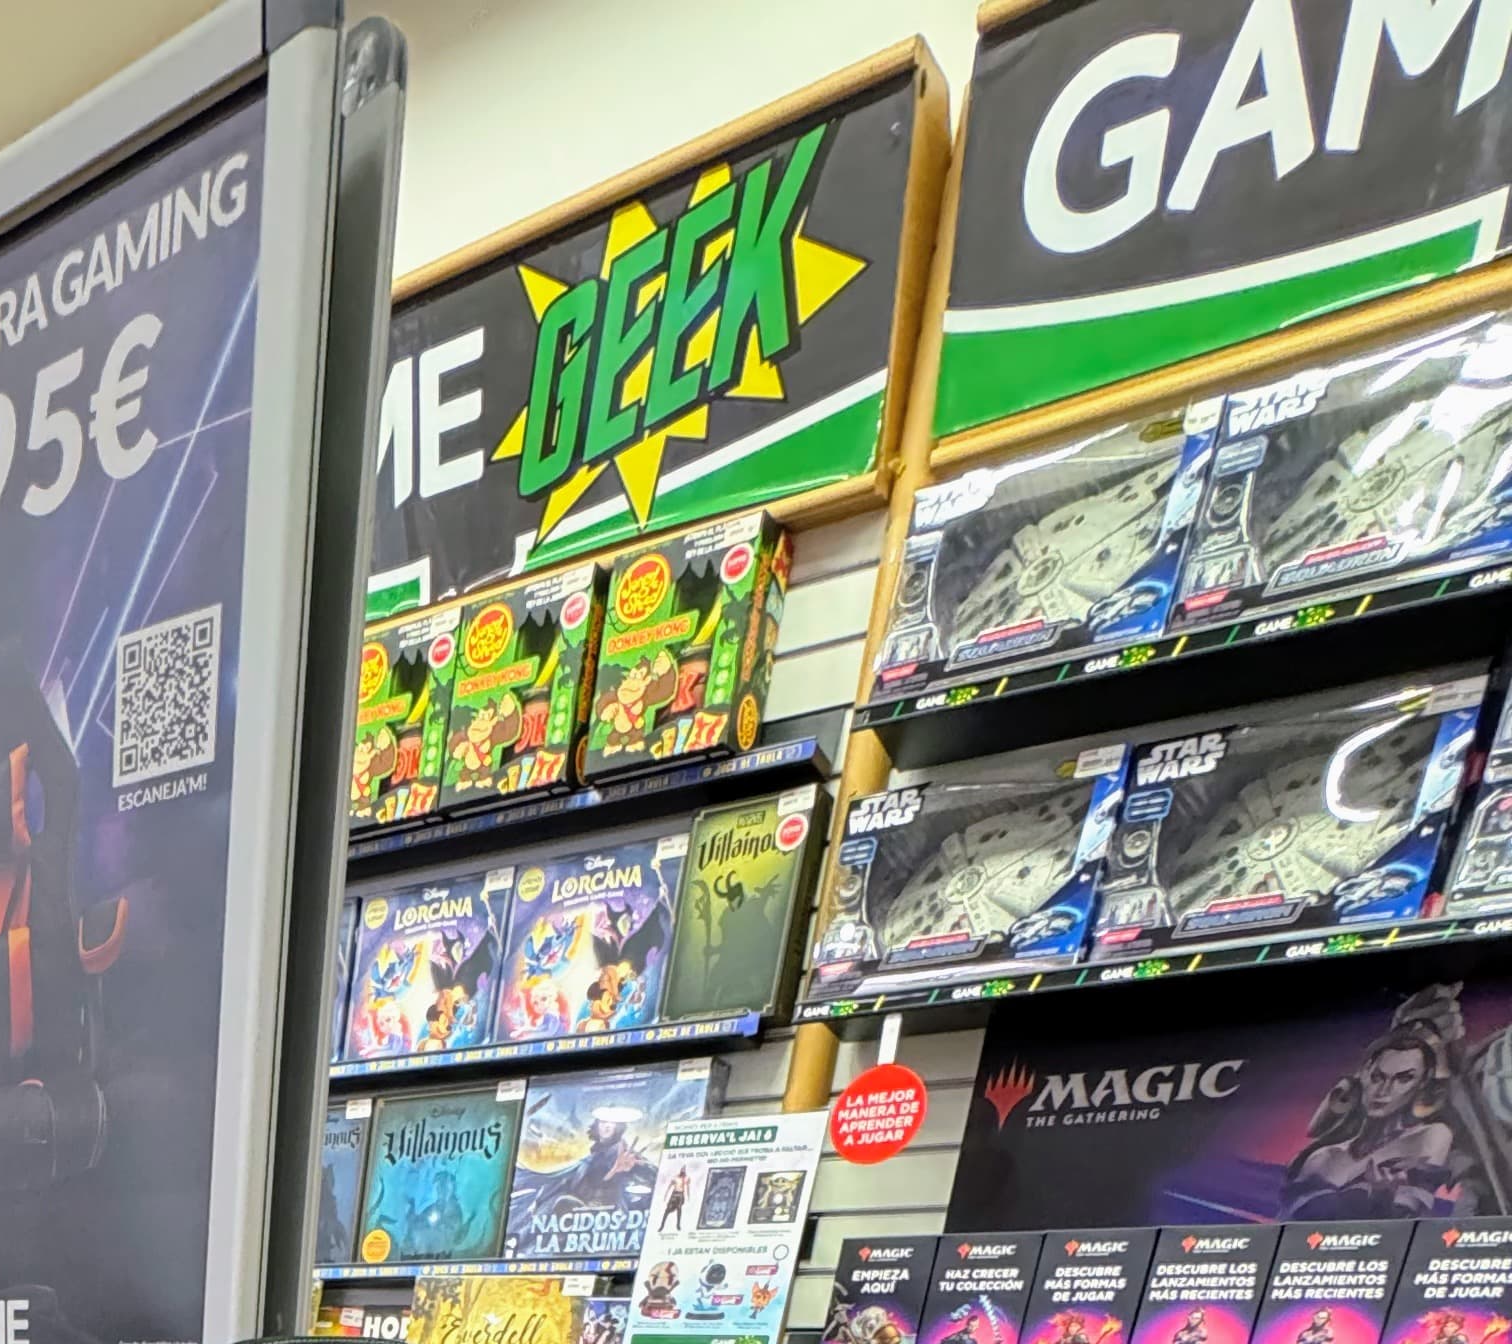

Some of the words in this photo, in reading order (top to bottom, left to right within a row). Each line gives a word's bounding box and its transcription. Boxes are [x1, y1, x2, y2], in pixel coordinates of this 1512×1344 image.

[51, 151, 250, 314] GAMING
[518, 122, 828, 496] GEEK
[1469, 566, 1512, 588] GAME
[1255, 616, 1293, 635] GAME
[1085, 656, 1120, 673] GAME
[916, 695, 947, 709] GAME
[1139, 733, 1228, 765] STAR
[1136, 751, 1226, 785] WARS
[117, 773, 208, 812] ESCANEJA'M!
[852, 788, 924, 817] STAR
[848, 804, 922, 834] WARS
[697, 828, 791, 871] Villaino
[584, 855, 615, 871] Disney
[551, 868, 643, 903] LORCANA
[394, 896, 473, 931] LORCANA
[1286, 943, 1324, 958] GAME
[1101, 966, 1135, 981] GAME
[951, 986, 982, 999] GAME
[1030, 1059, 1246, 1112] MAGIC
[845, 1095, 864, 1107] LA
[867, 1088, 916, 1104] MEJOR
[838, 1105, 895, 1121] MANERA
[899, 1102, 919, 1114] DE
[1026, 1116, 1056, 1128] THE
[1062, 1108, 1161, 1126] GATHERING
[839, 1116, 914, 1134] APRENDER
[383, 1118, 503, 1167] Villainous
[669, 1131, 736, 1149] RESERVA'L
[857, 1129, 905, 1146] JUGAR
[530, 1210, 626, 1234] NACIDOS
[534, 1233, 561, 1254] LA
[564, 1230, 641, 1253] BRUMA
[1077, 1241, 1129, 1253] MAGIC
[1195, 1237, 1251, 1250] MAGIC
[1321, 1233, 1382, 1247] MAGIC
[869, 1247, 915, 1259] MAGIC
[969, 1244, 1017, 1257] MAGIC
[945, 1269, 970, 1280] HAZ
[971, 1268, 1020, 1279] CRECER
[1055, 1265, 1123, 1278] DESCUBRE
[1156, 1264, 1227, 1276] DESCUBRE
[1229, 1263, 1258, 1275] LOS
[1279, 1260, 1356, 1273] DESCUBRE
[1358, 1260, 1389, 1272] LOS
[851, 1268, 910, 1282] EMPIEZA
[1150, 1276, 1257, 1289] LANZAMIENTOS
[1272, 1274, 1388, 1287] LANZAMIENTOS
[1414, 1271, 1449, 1286] MÁS
[860, 1280, 897, 1294] AQUÍ
[939, 1281, 955, 1291] TU
[955, 1279, 1024, 1292] COLECCIÓN
[1044, 1278, 1071, 1291] MÁS
[1072, 1277, 1127, 1290] FORMAS
[1052, 1291, 1070, 1302] DE
[1071, 1291, 1115, 1302] JUGAR
[1148, 1288, 1178, 1301] MÁS
[1179, 1288, 1254, 1301] RECIENTES
[1271, 1286, 1303, 1299] MÁS
[1304, 1287, 1385, 1300] RECIENTES
[1423, 1286, 1447, 1299] DE
[1448, 1286, 1505, 1299] JUGAR
